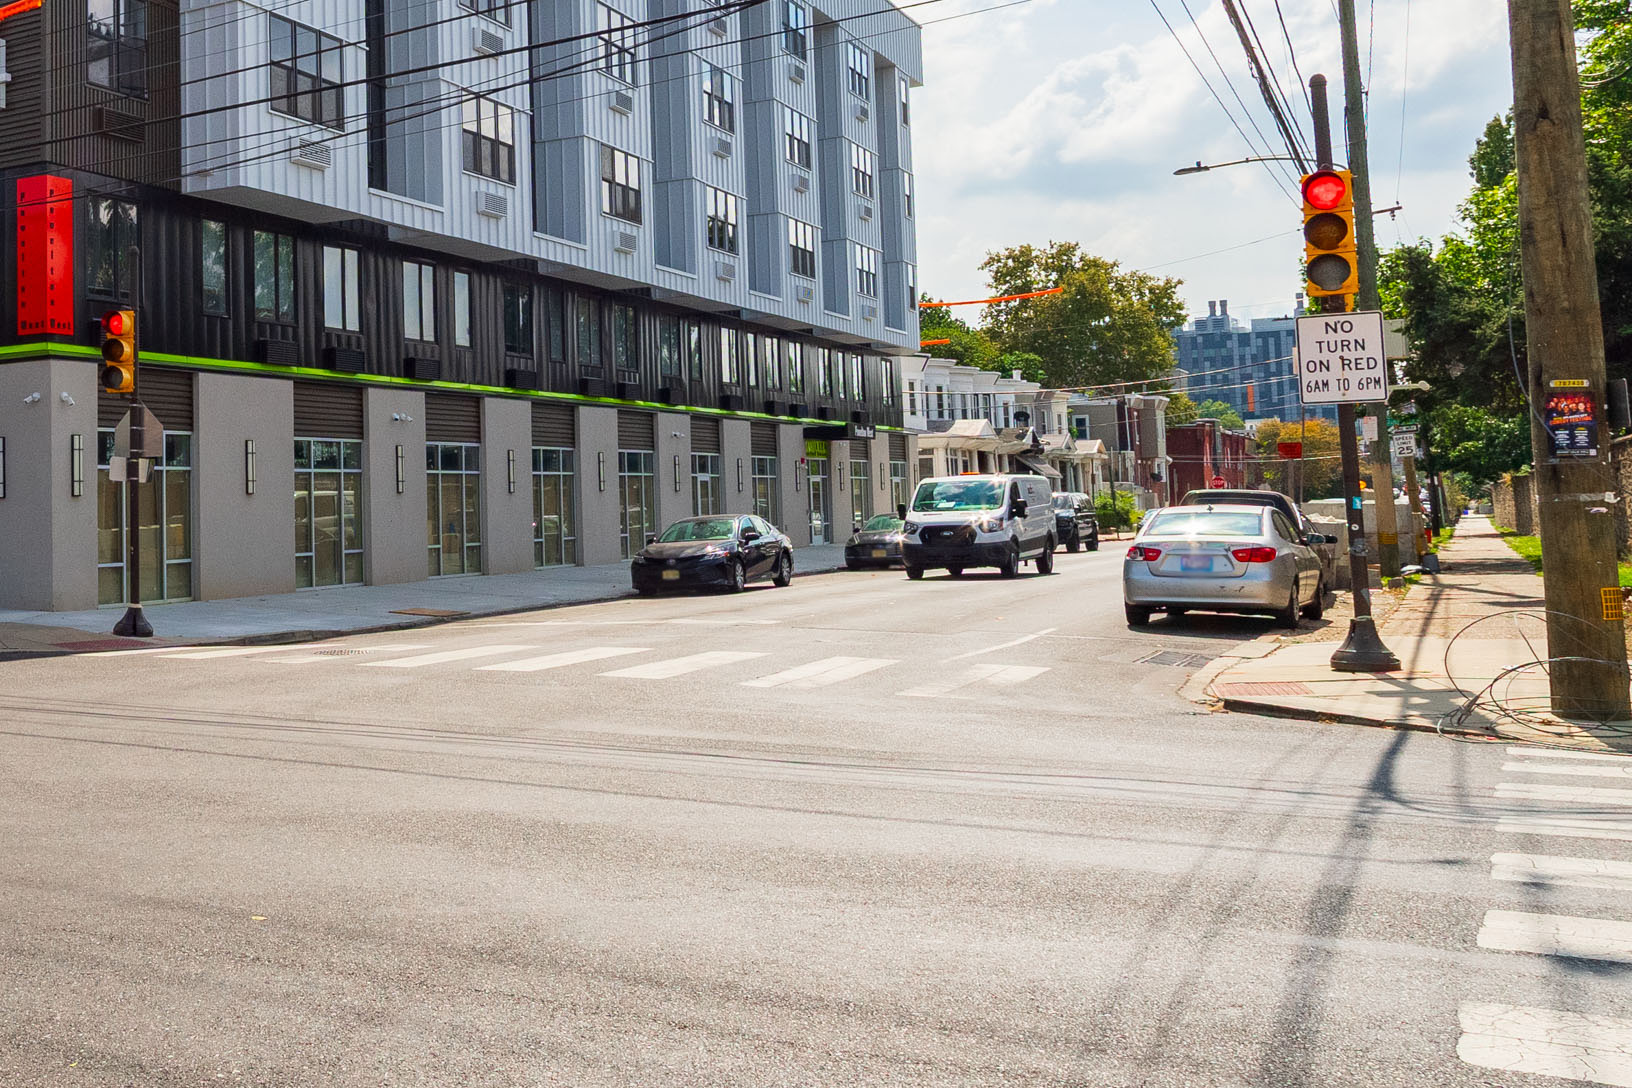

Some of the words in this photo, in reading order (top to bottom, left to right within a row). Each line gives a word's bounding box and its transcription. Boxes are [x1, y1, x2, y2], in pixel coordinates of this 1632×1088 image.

[1324, 320, 1353, 334] NO
[1315, 338, 1366, 353] TURN
[1306, 359, 1330, 373] ON
[1341, 356, 1377, 372] RED
[1306, 379, 1329, 393] 6AM
[1336, 377, 1350, 392] TO
[1357, 376, 1382, 391] 6PM
[1398, 446, 1414, 455] 25
